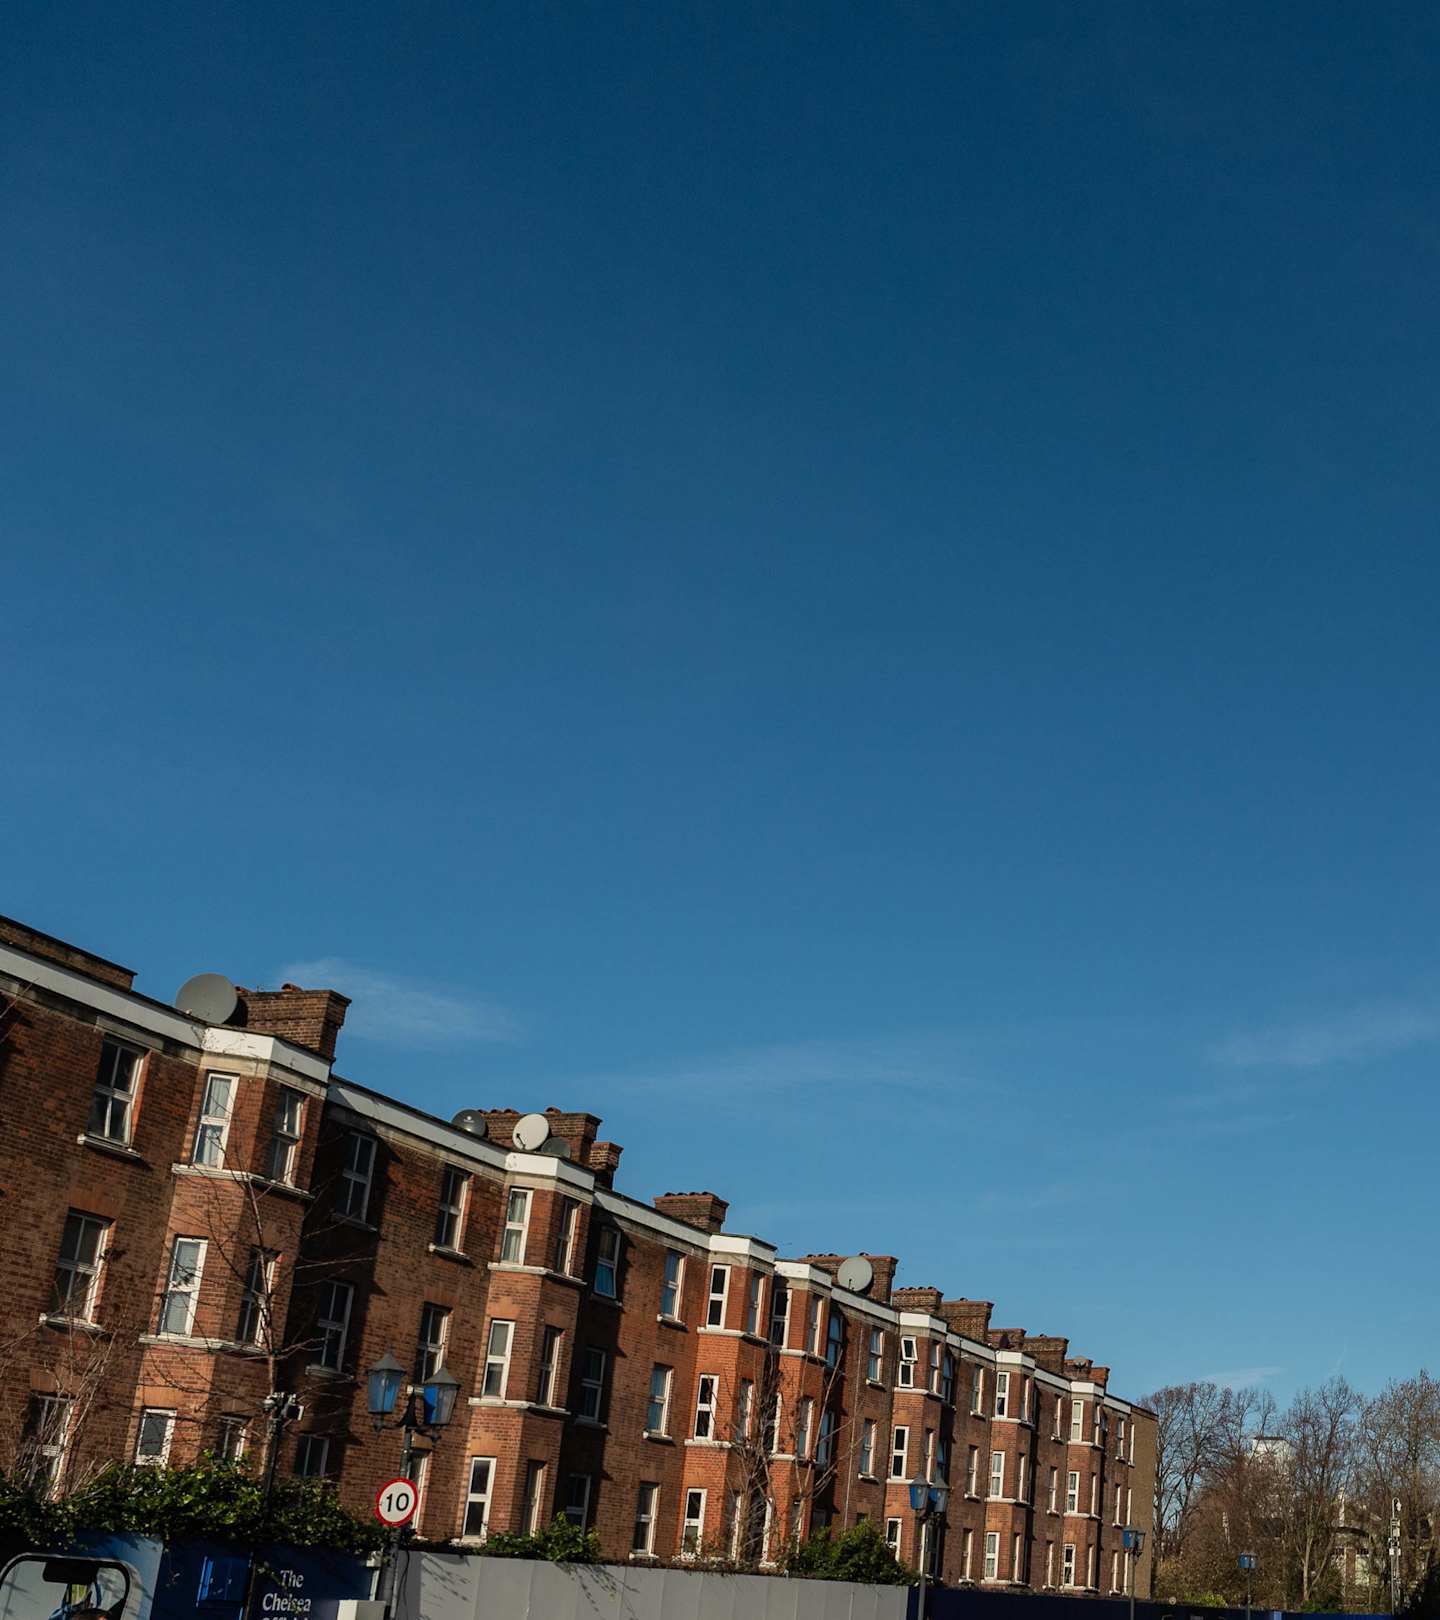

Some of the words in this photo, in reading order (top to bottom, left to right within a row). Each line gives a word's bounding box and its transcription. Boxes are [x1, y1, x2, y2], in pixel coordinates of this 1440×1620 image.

[386, 1493, 410, 1513] 10
[280, 1569, 304, 1588] The
[262, 1593, 312, 1613] Chelsea
